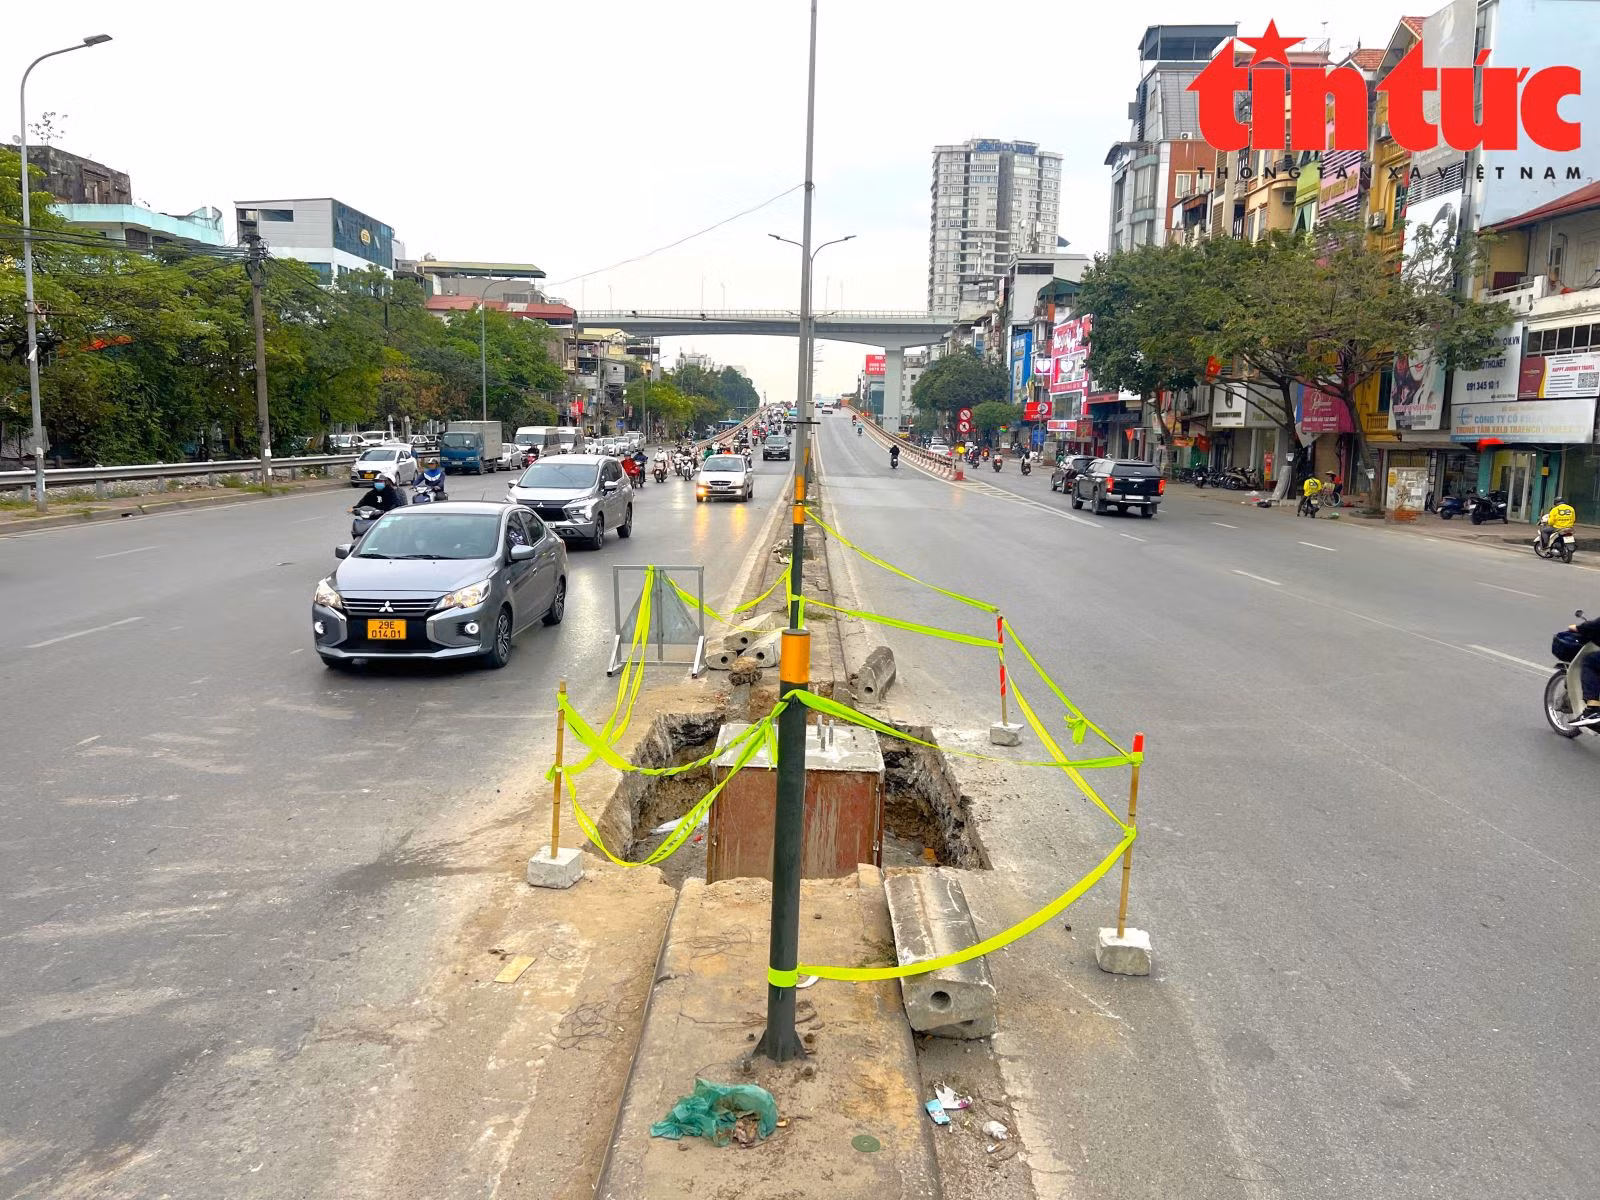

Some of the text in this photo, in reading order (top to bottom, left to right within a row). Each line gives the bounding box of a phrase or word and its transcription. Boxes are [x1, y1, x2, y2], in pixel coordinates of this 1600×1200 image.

[1496, 414, 1506, 423] TY
[378, 621, 395, 630] 29E
[371, 630, 401, 638] 014.01
